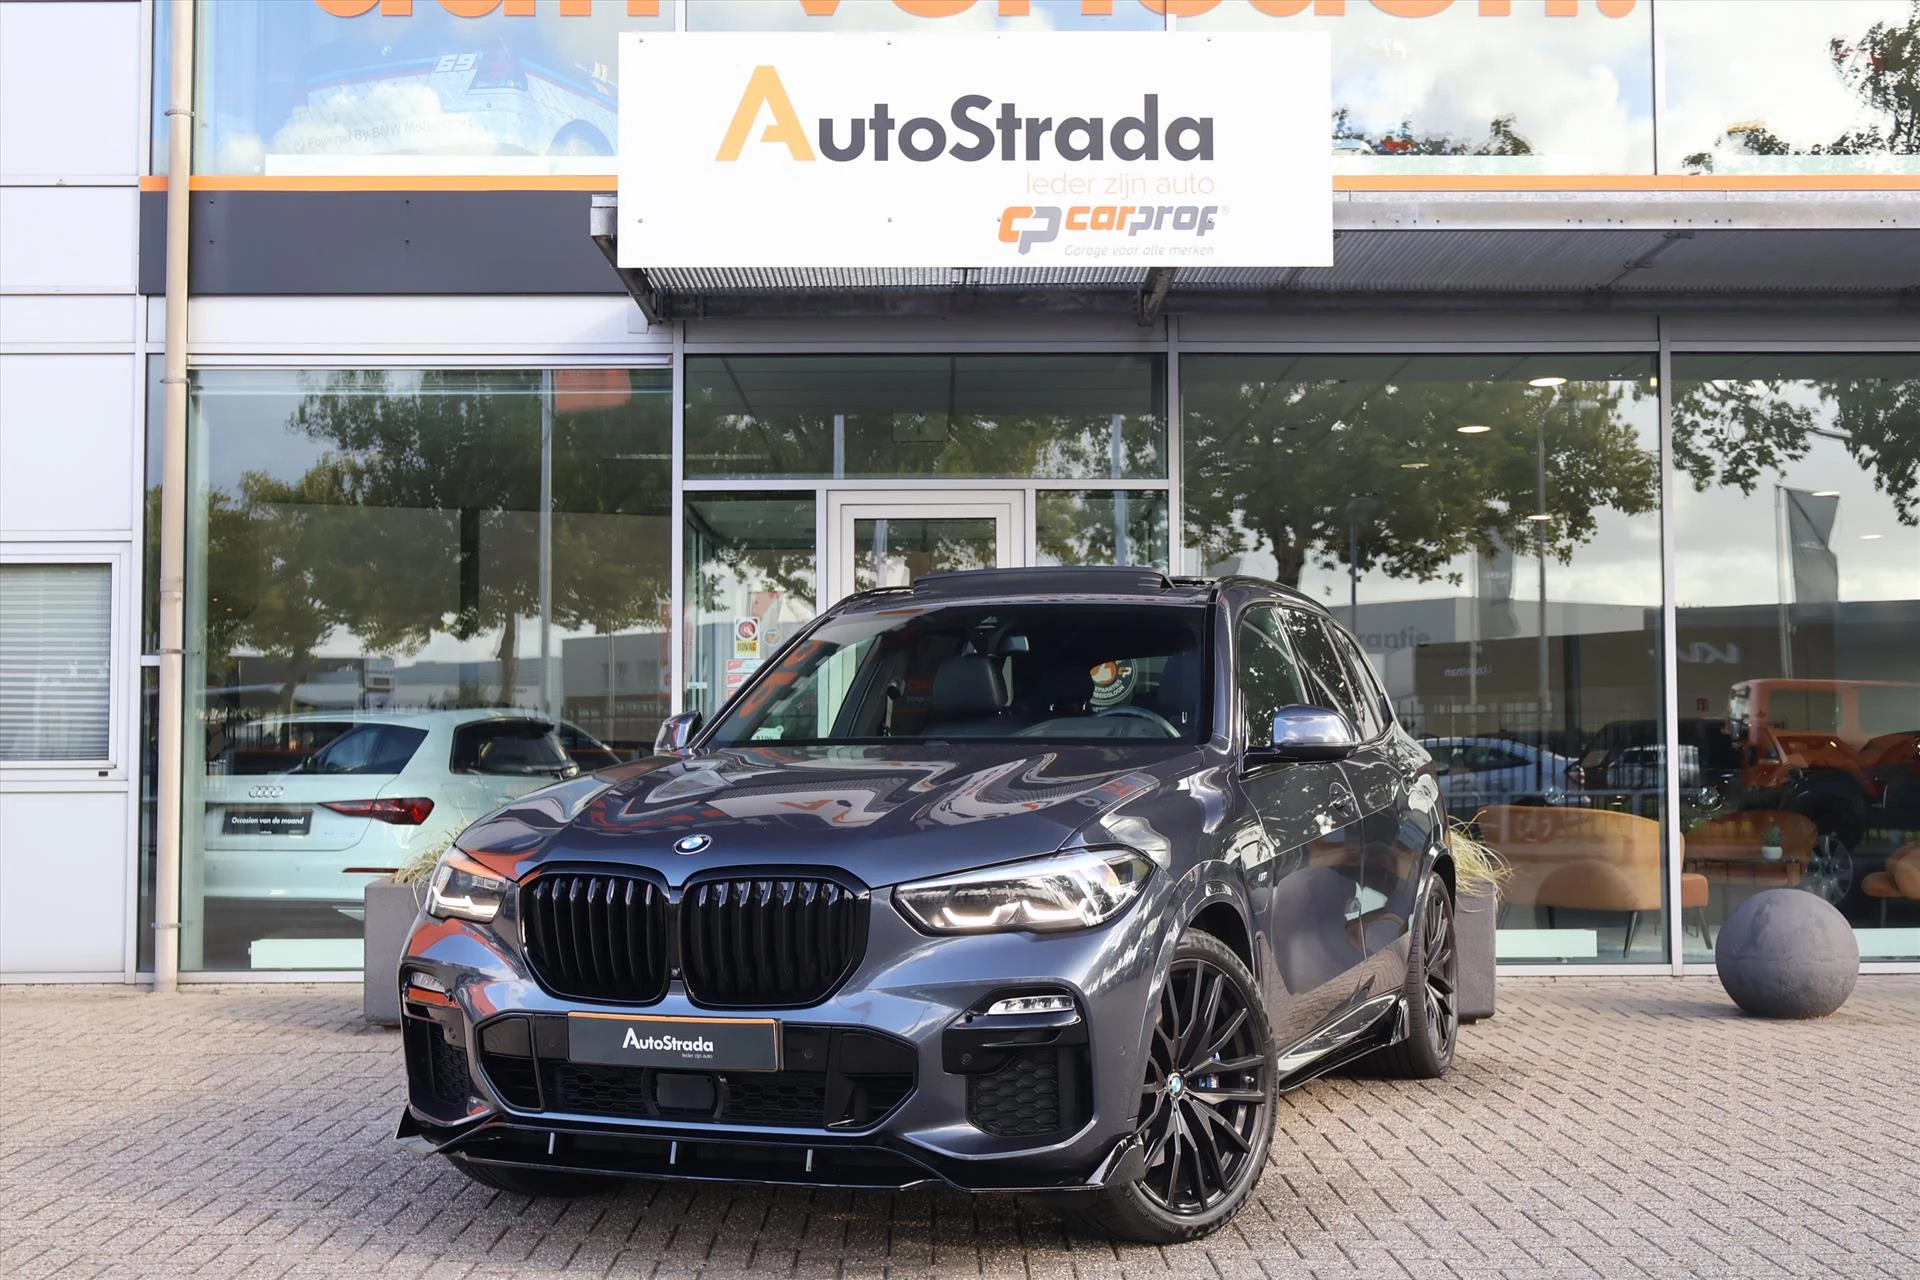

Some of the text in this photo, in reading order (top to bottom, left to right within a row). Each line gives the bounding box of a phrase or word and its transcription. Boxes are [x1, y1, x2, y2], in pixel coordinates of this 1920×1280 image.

[435, 53, 478, 73] 69
[715, 65, 1214, 162] AutoStrada
[371, 123, 401, 139] BMW
[1026, 173, 1215, 200] Ieder zijn auto
[1064, 244, 1214, 259] Garage voor alle merken
[1359, 626, 1431, 649] rantie
[1094, 679, 1122, 693] EPARATIES
[231, 816, 259, 825] Occasion
[272, 816, 280, 825] de
[281, 816, 304, 825] maand
[622, 1027, 714, 1052] AutoStrada
